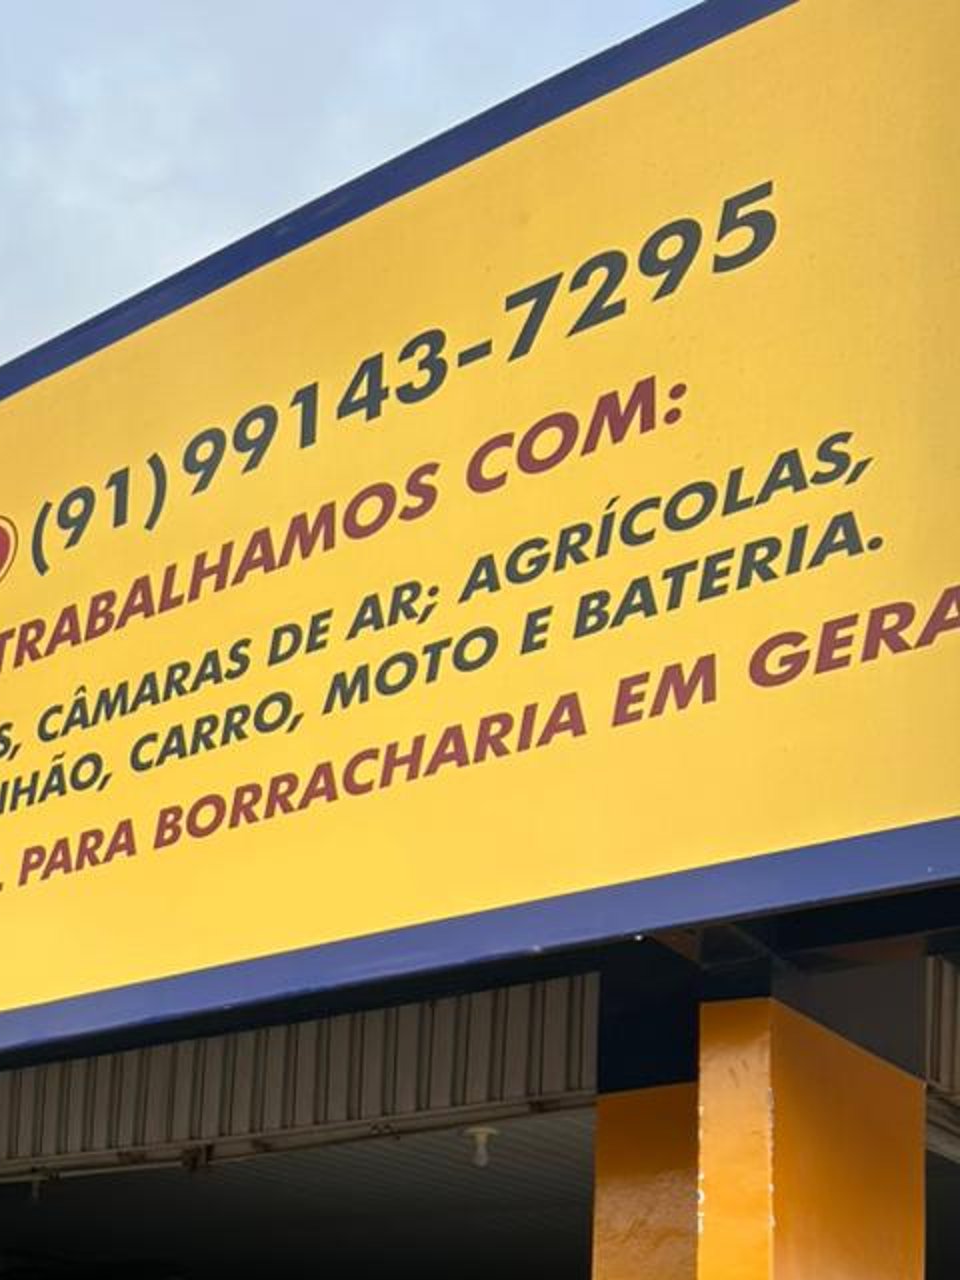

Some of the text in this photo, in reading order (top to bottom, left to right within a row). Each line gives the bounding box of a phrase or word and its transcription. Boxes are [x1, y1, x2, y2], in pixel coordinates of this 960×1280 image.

[467, 376, 686, 493] COM:
[38, 639, 251, 742] CÂMARAS
[268, 609, 333, 666] DE
[346, 581, 439, 640] AR;
[458, 432, 872, 603] AGRÍCOLAS,
[130, 692, 303, 772] CARRO,
[323, 627, 498, 714] MOTO
[520, 606, 553, 654] E
[573, 511, 883, 639] BATERIA.
[19, 819, 135, 885] PARA
[154, 693, 586, 848] BORRACHARIA
[613, 654, 715, 726] EM
